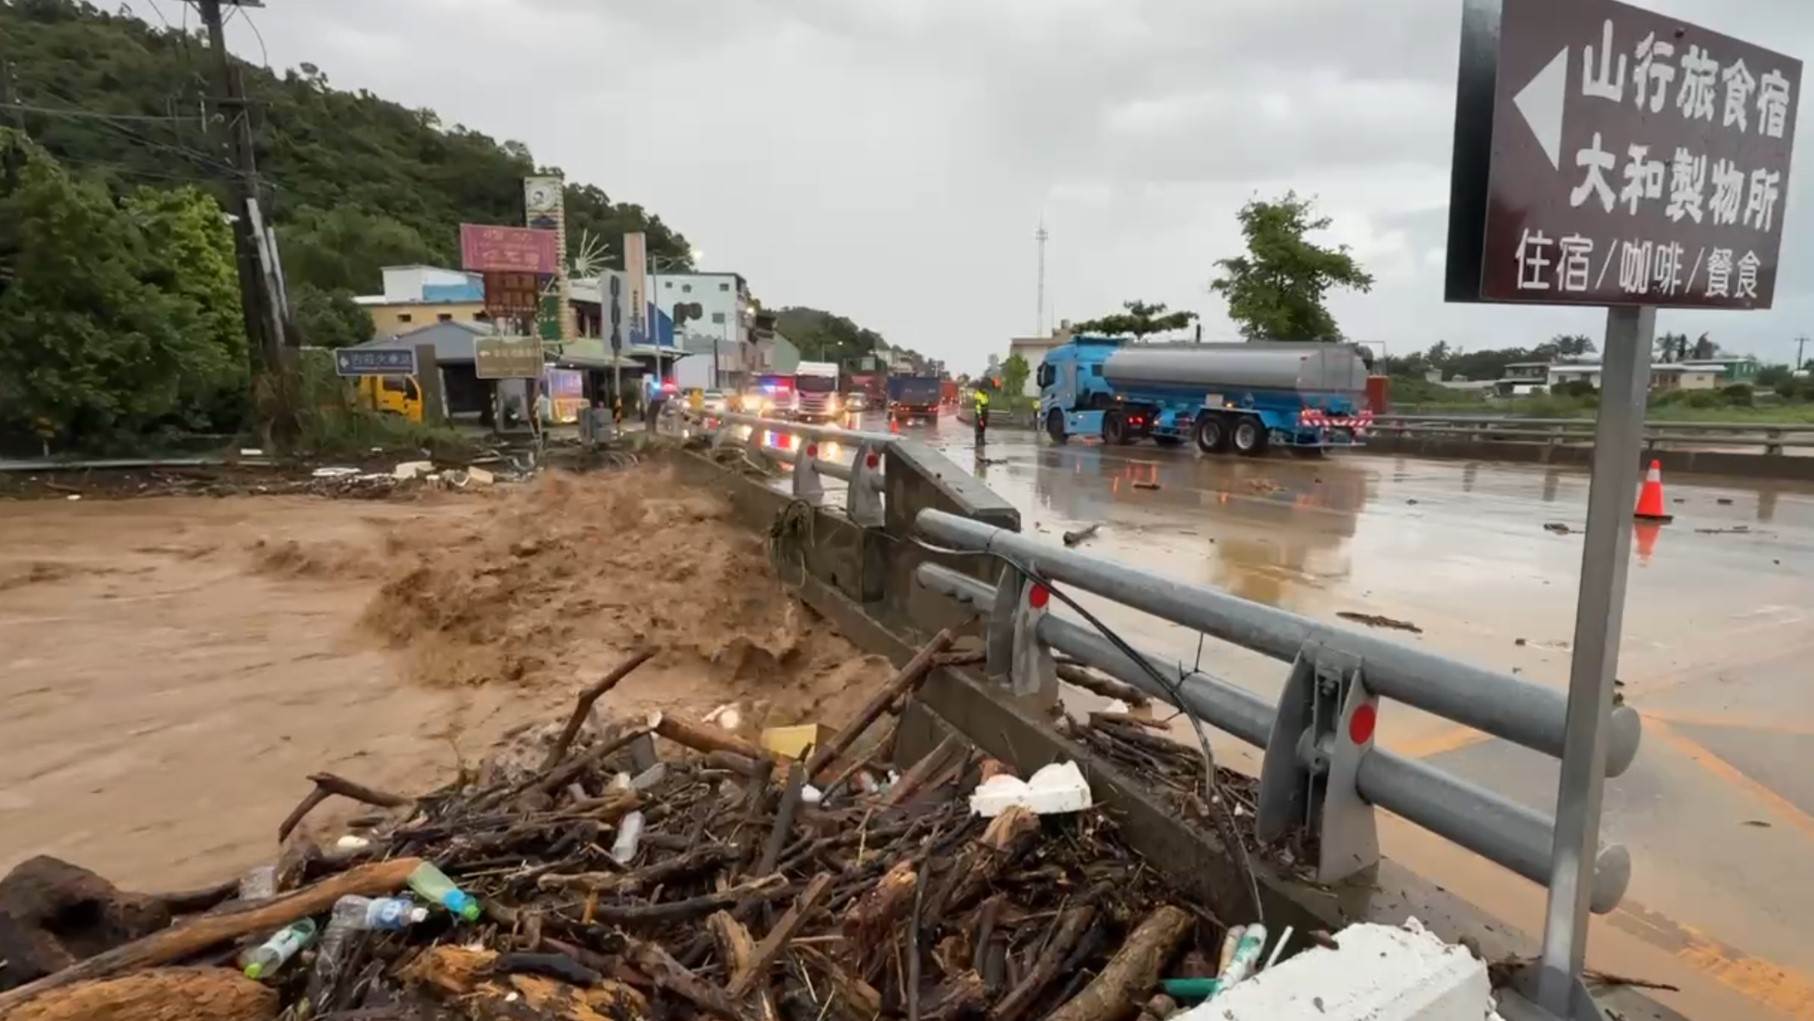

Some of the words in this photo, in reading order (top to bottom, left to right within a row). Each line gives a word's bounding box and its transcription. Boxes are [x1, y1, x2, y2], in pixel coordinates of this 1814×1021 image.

[1582, 19, 1790, 138] 山行旅食宿
[1570, 132, 1780, 232] 大和製物所
[1515, 228, 1761, 298] 住宿/咖啡/餐食
